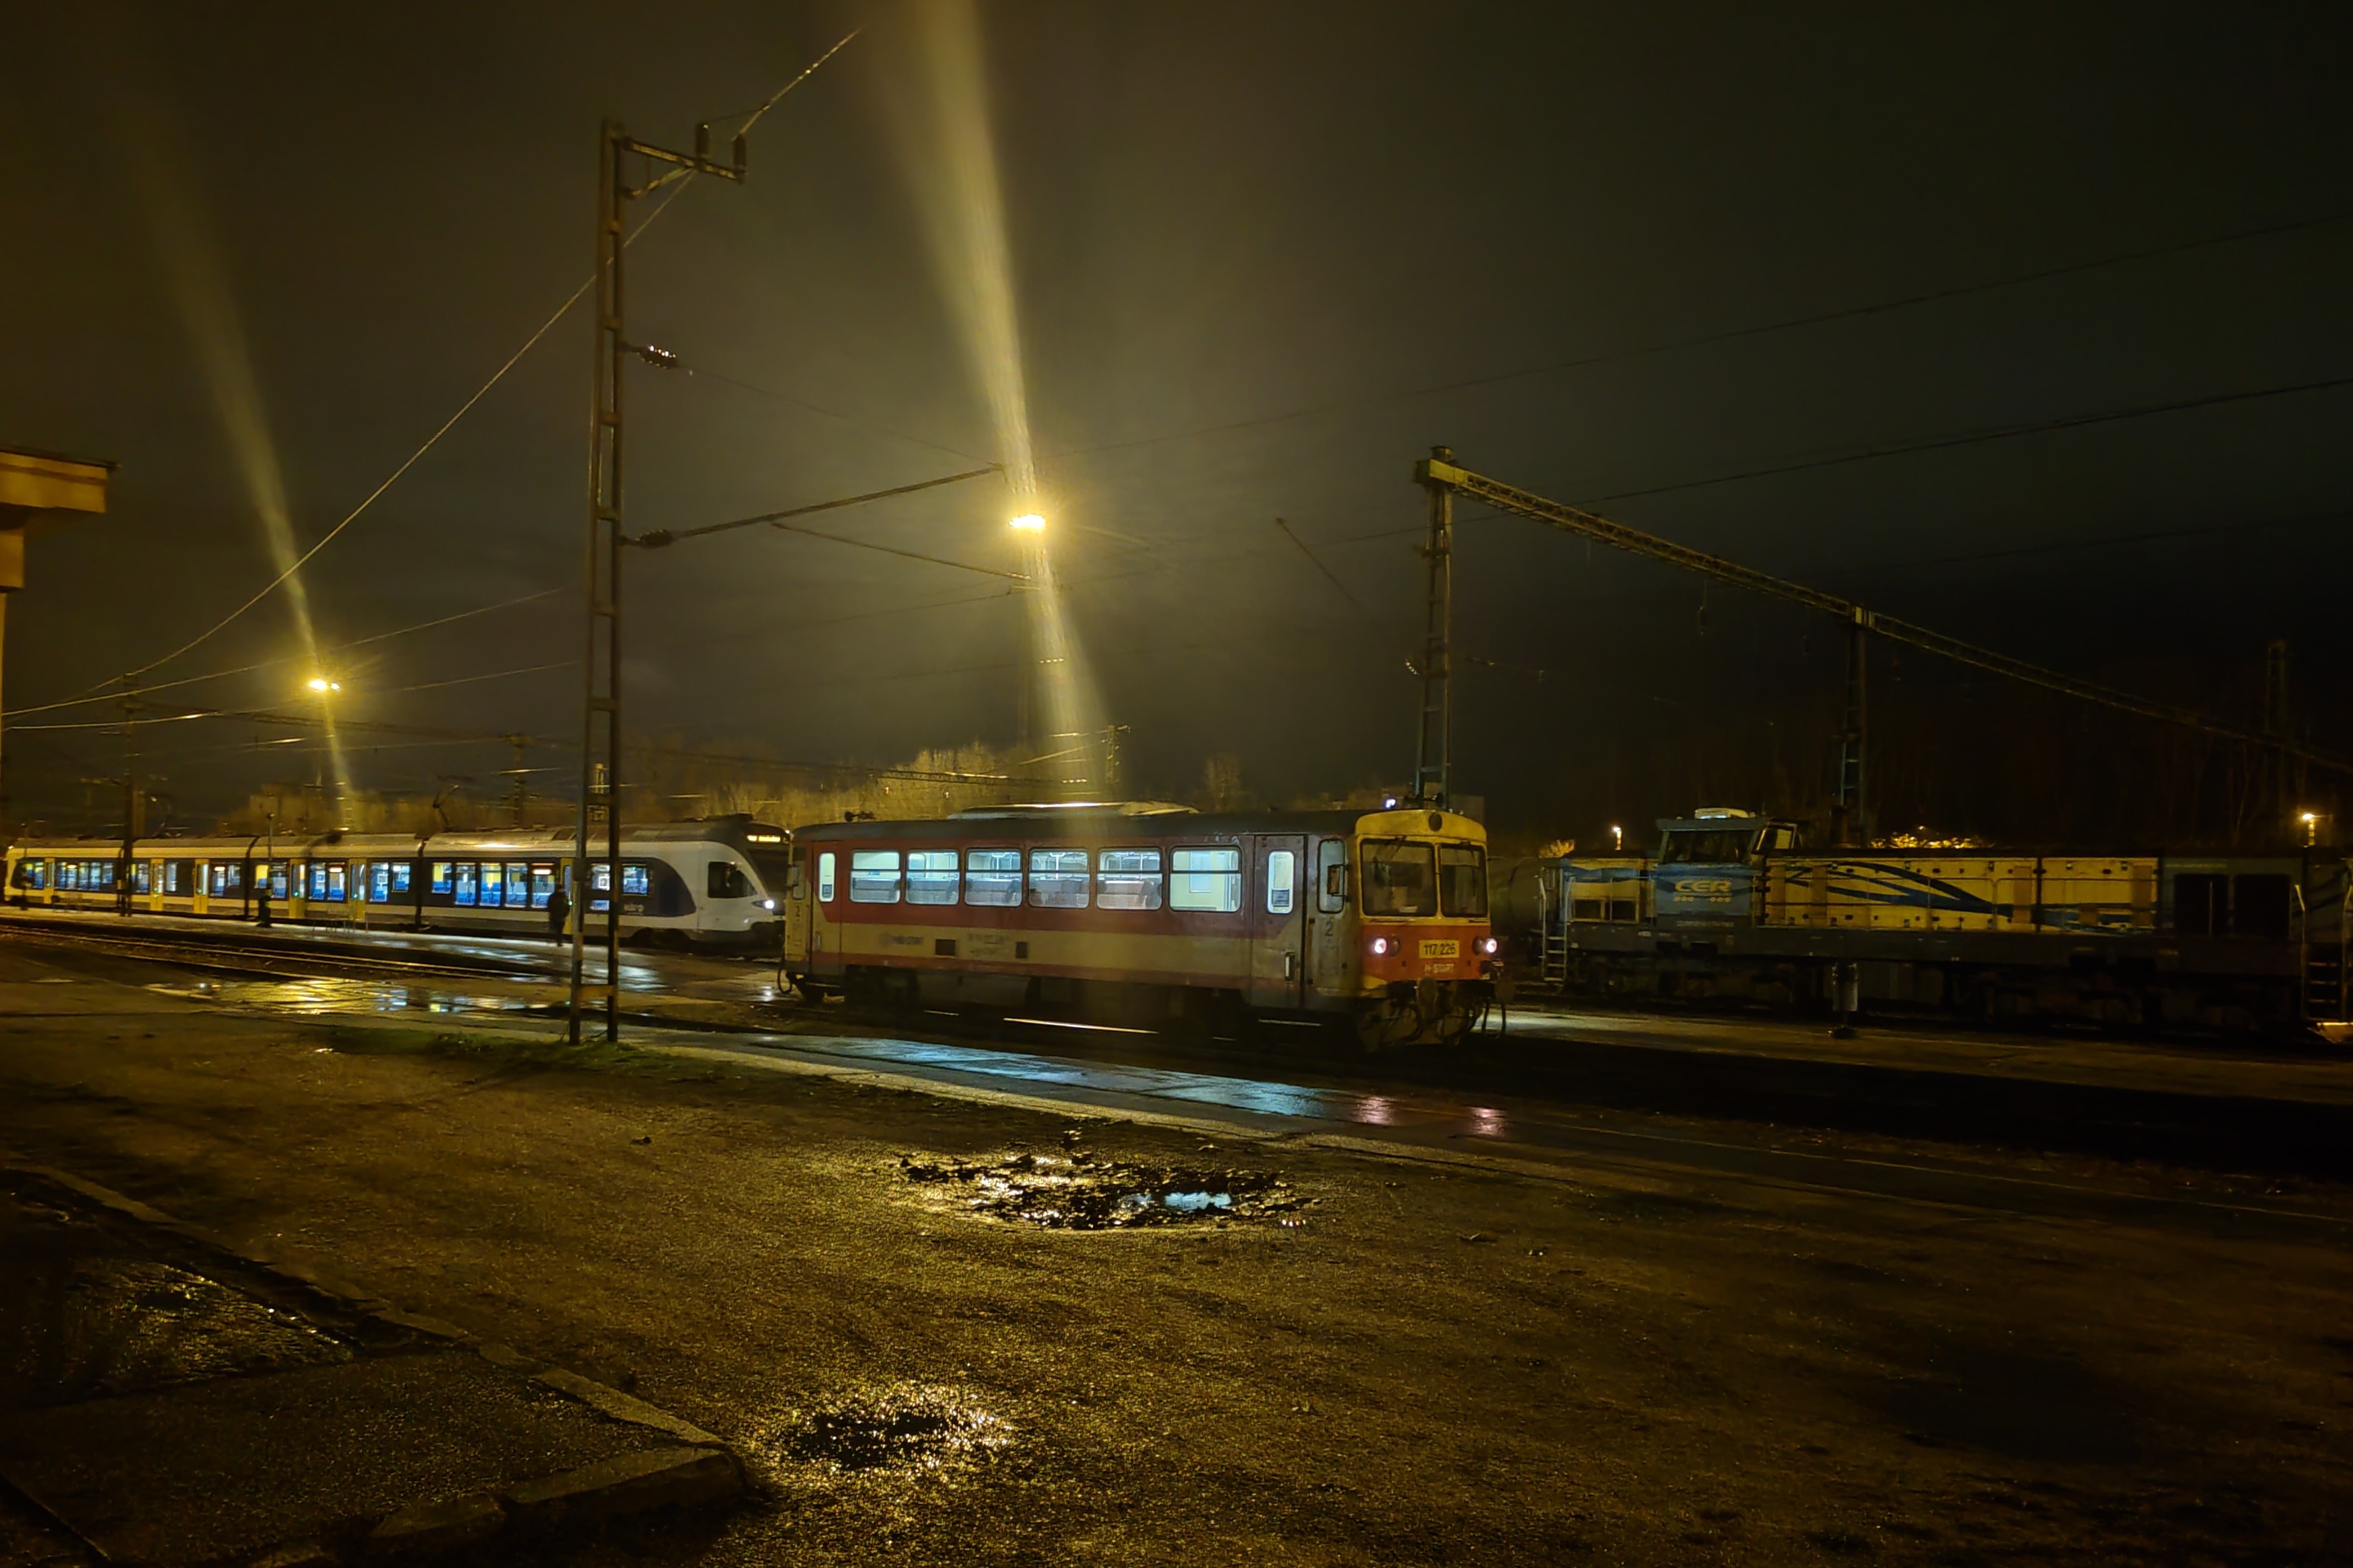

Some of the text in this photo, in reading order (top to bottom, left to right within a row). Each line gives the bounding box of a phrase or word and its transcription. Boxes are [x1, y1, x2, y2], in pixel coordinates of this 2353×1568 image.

[1674, 880, 1732, 893] CER
[1325, 920, 1333, 937] 2
[1424, 943, 1438, 955] 117
